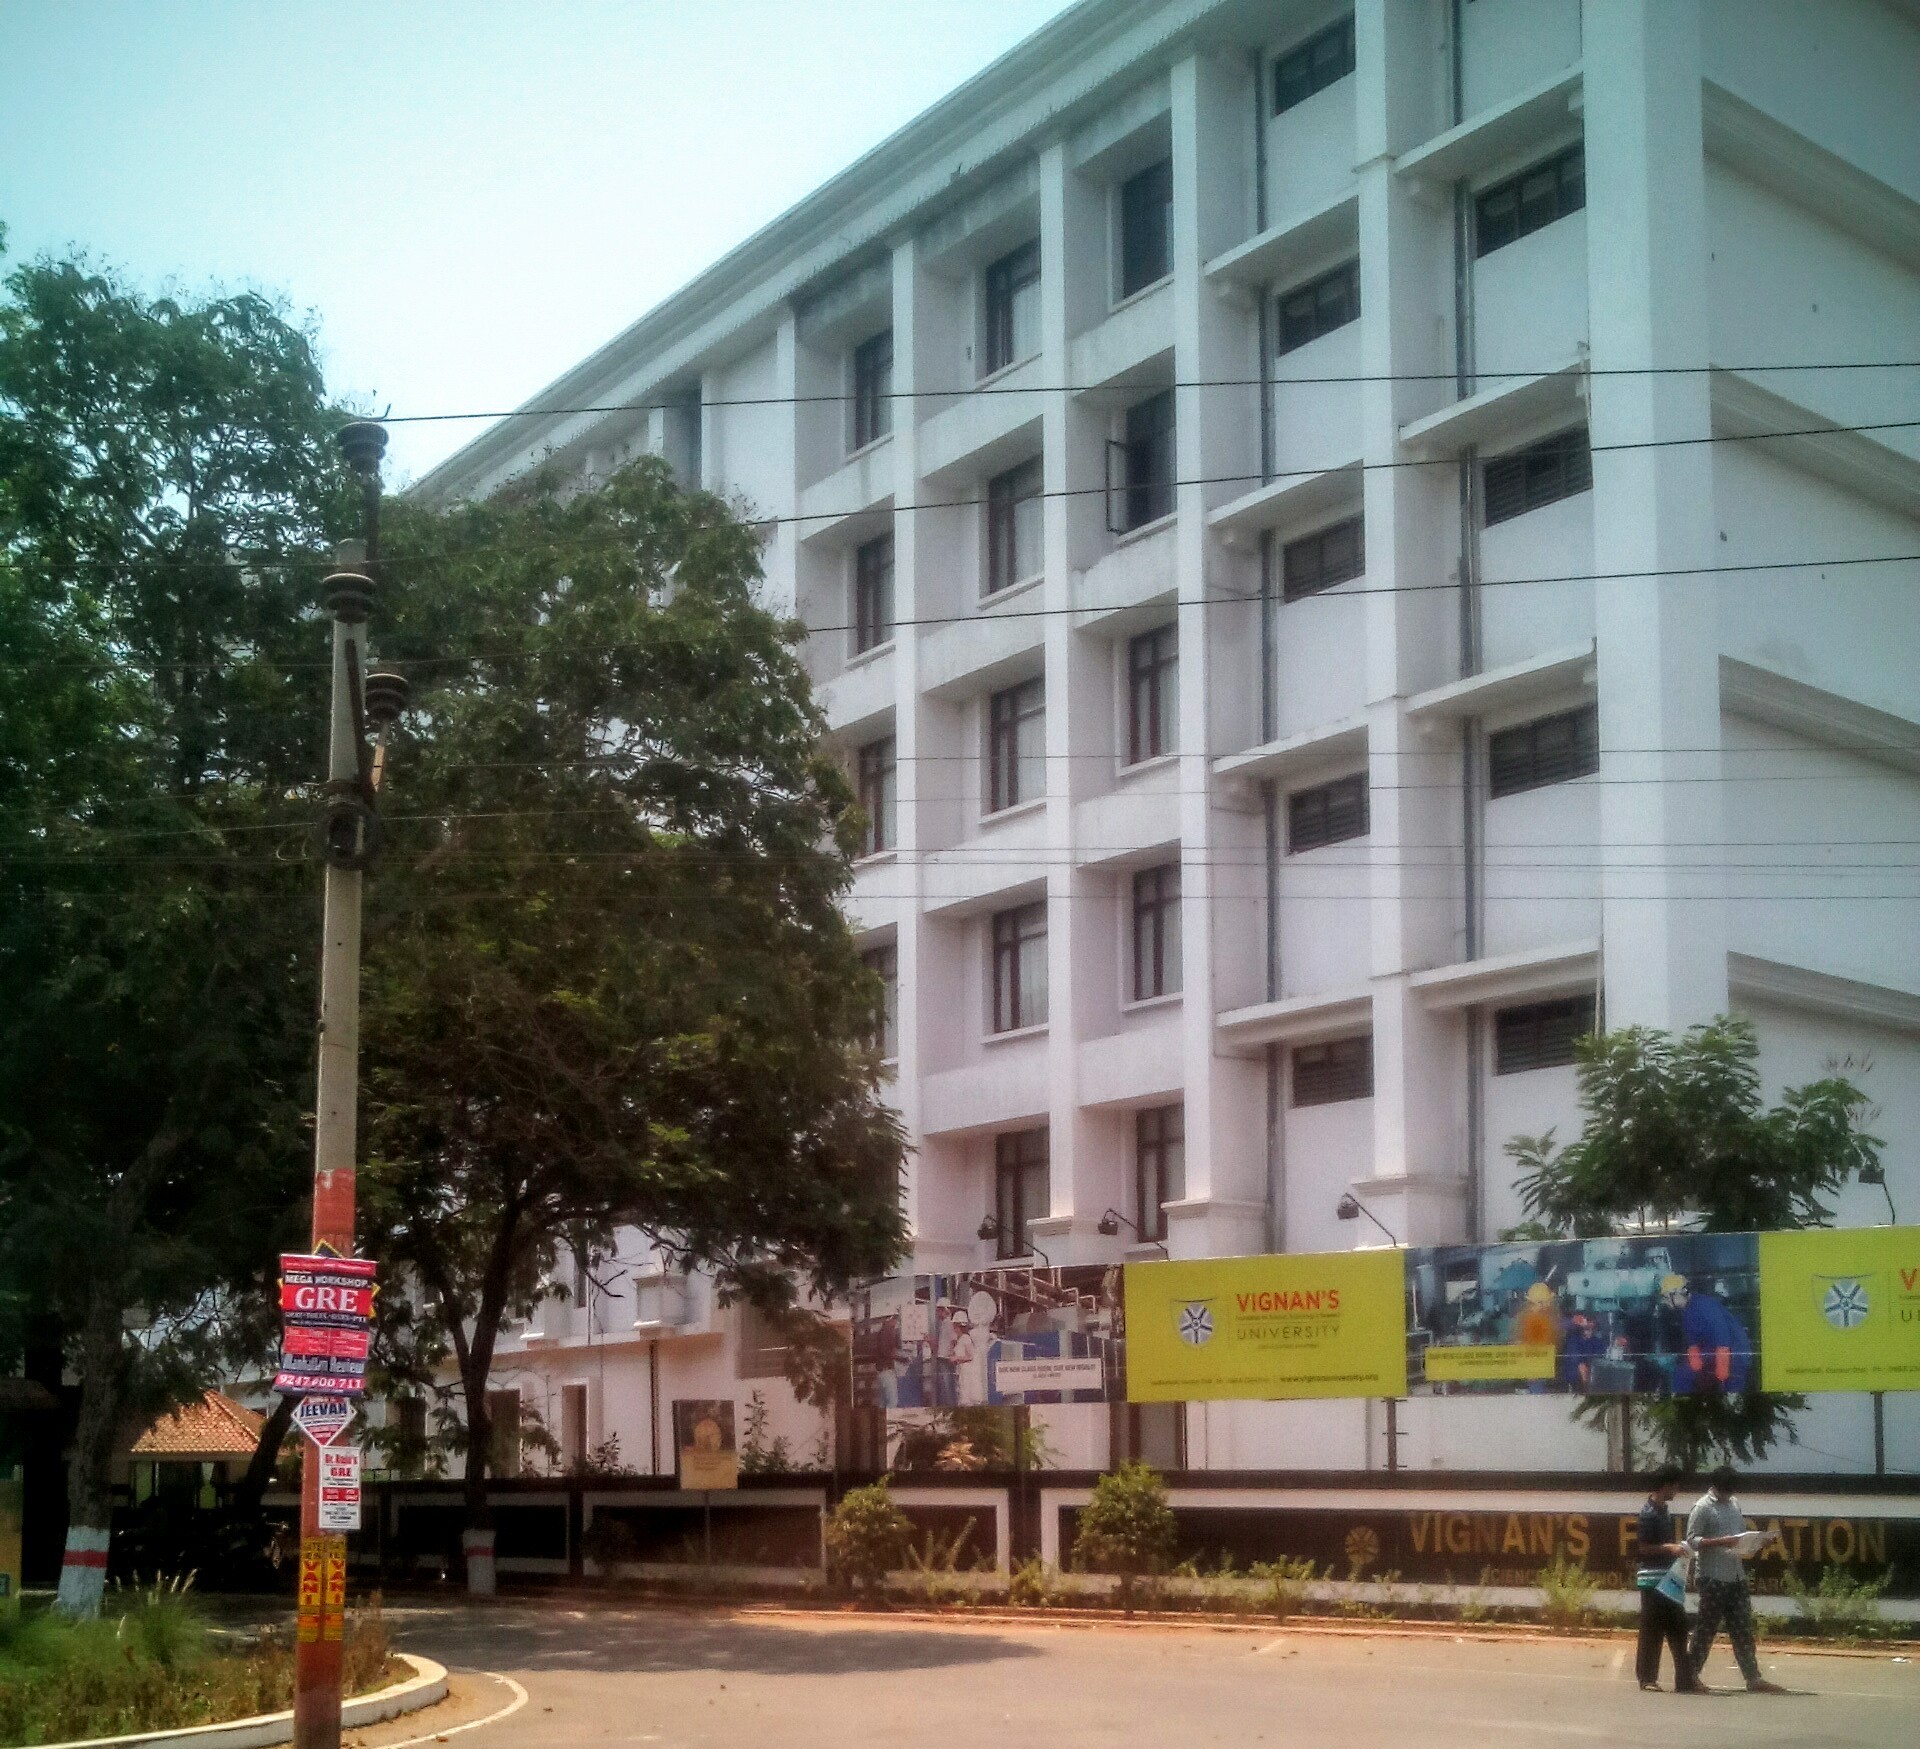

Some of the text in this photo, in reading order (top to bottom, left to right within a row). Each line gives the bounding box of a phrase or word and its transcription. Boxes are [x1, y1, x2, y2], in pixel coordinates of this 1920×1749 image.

[295, 1286, 359, 1312] GRE
[1236, 1289, 1340, 1312] VIGNAN'S
[1237, 1325, 1340, 1340] UNIVERSITY
[300, 1402, 347, 1417] JEEVAN
[1409, 1511, 1591, 1556] VIGNAN'S
